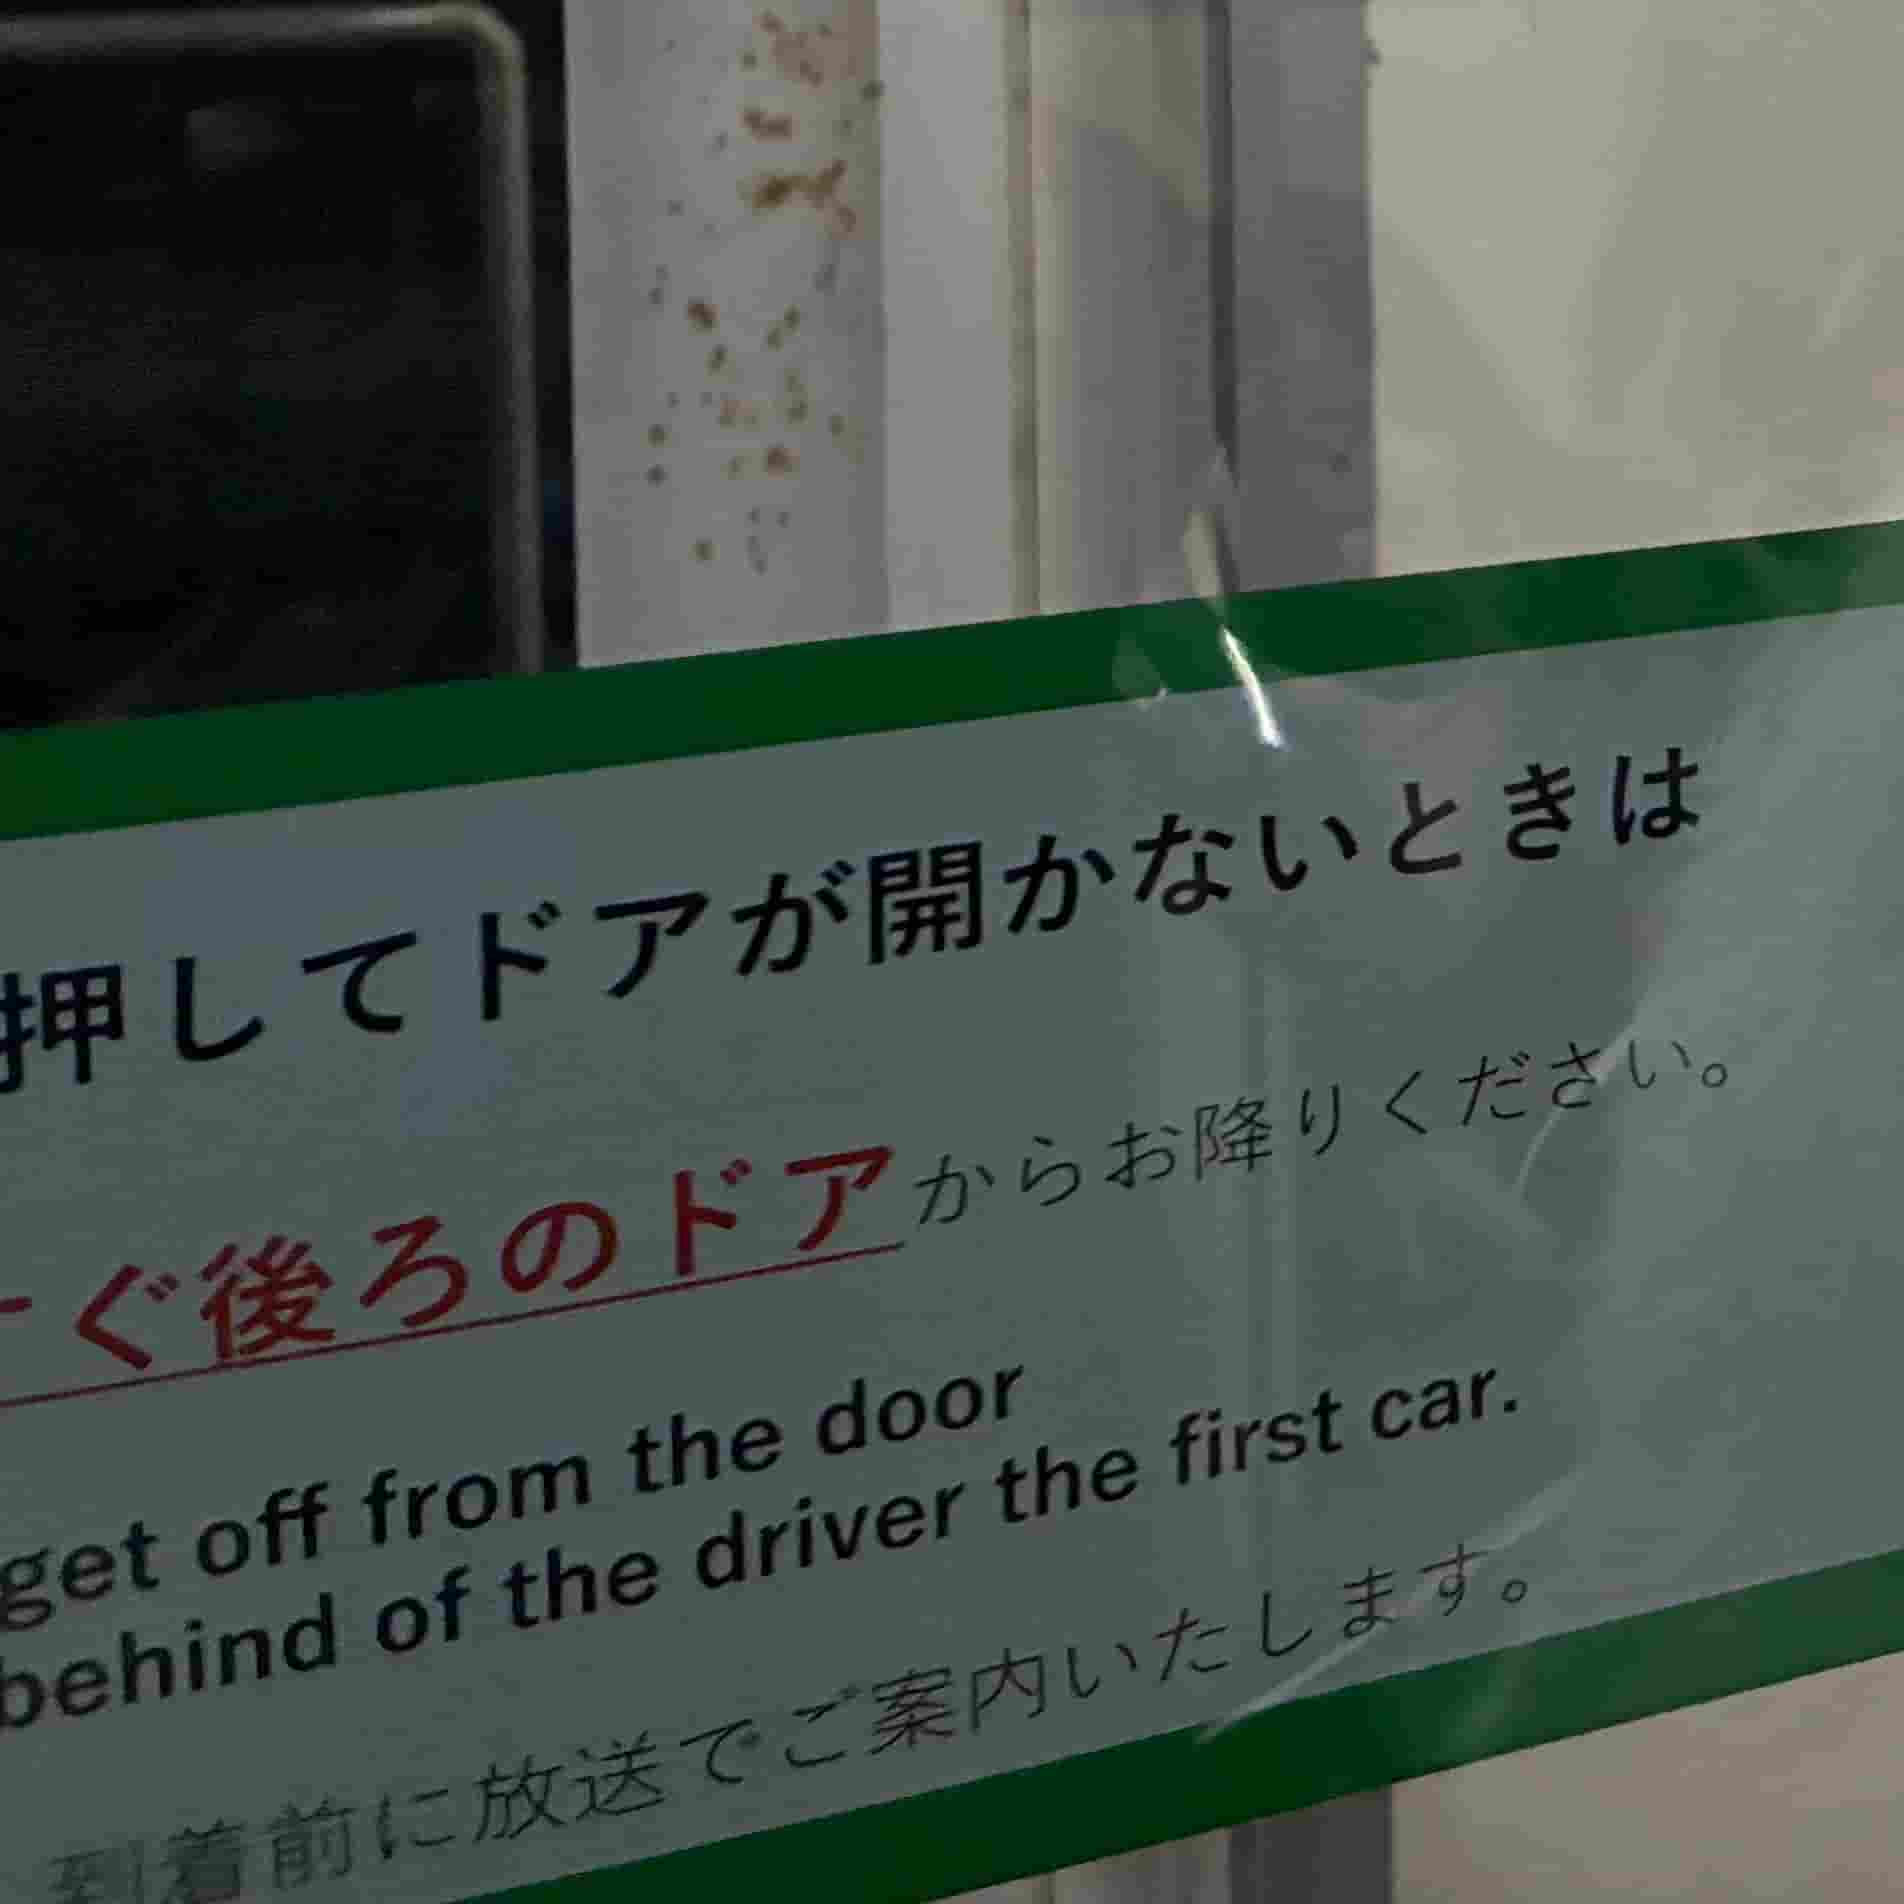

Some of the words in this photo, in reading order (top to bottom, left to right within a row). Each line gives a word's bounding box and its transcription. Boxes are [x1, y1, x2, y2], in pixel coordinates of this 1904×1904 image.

[0, 746, 1702, 1094] 押してドアが開かないときは
[0, 1037, 1730, 1370] ぐ後ろのドアからお降りください。
[0, 1521, 160, 1631] get
[196, 1481, 330, 1577] off
[363, 1453, 592, 1546] from
[627, 1411, 783, 1494] the
[815, 1363, 1025, 1456] door
[0, 1592, 337, 1730] behind
[375, 1565, 471, 1654] of
[503, 1545, 662, 1629] the
[694, 1477, 968, 1591] driver
[999, 1443, 1140, 1526] the
[1168, 1388, 1344, 1486] first
[1369, 1366, 1521, 1442] car.
